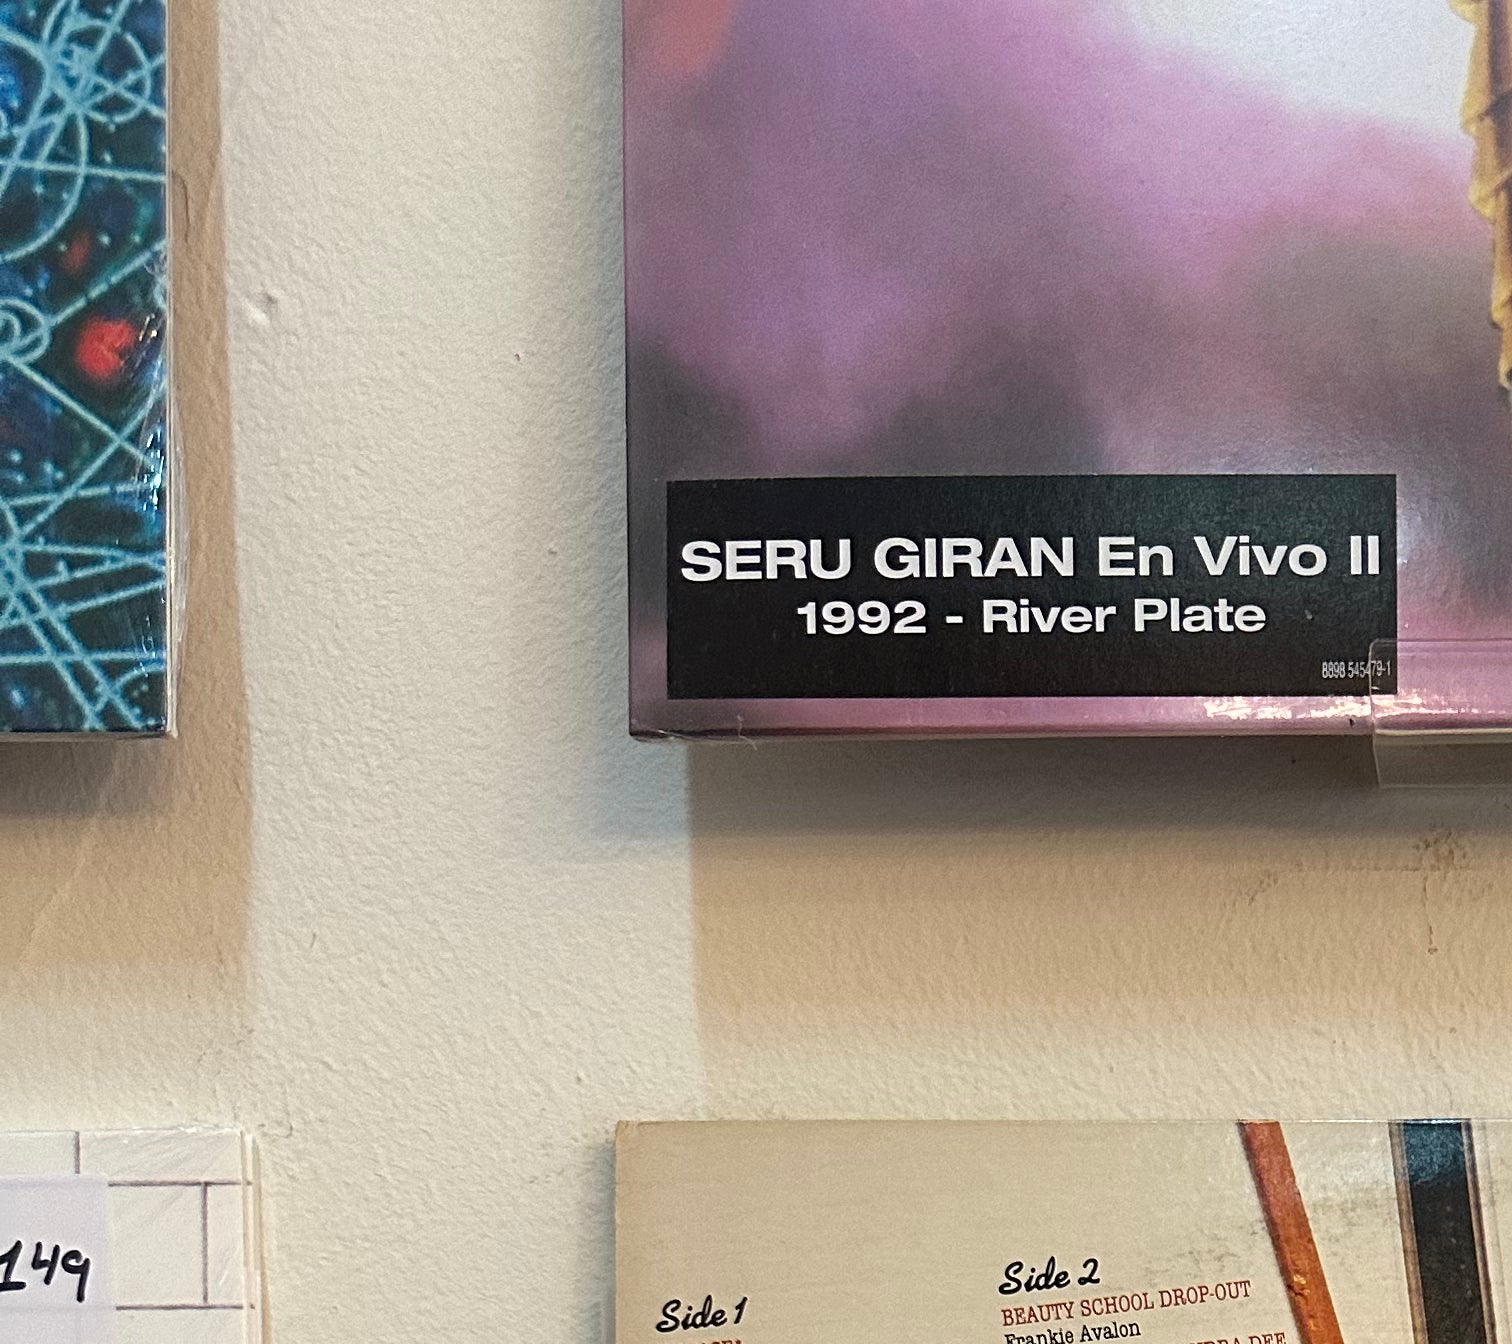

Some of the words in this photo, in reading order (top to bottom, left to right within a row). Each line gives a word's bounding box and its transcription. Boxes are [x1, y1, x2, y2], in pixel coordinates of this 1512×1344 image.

[681, 539, 850, 581] SERU
[874, 537, 1073, 578] GIRAN
[1099, 537, 1173, 576] En
[1194, 536, 1326, 575] Vivo
[1351, 536, 1379, 574] II
[798, 601, 926, 634] 1992
[983, 599, 1116, 632] River
[1135, 598, 1265, 632] Plate
[998, 1256, 1070, 1295] Side
[1078, 1258, 1100, 1286] 2
[655, 1294, 727, 1332] Side
[734, 1297, 748, 1324] 1
[1001, 1301, 1074, 1326] BEAUTY
[1080, 1292, 1154, 1316] SCHOOL
[1158, 1280, 1250, 1308] DROP-OUT
[1080, 1321, 1141, 1342] Avalon
